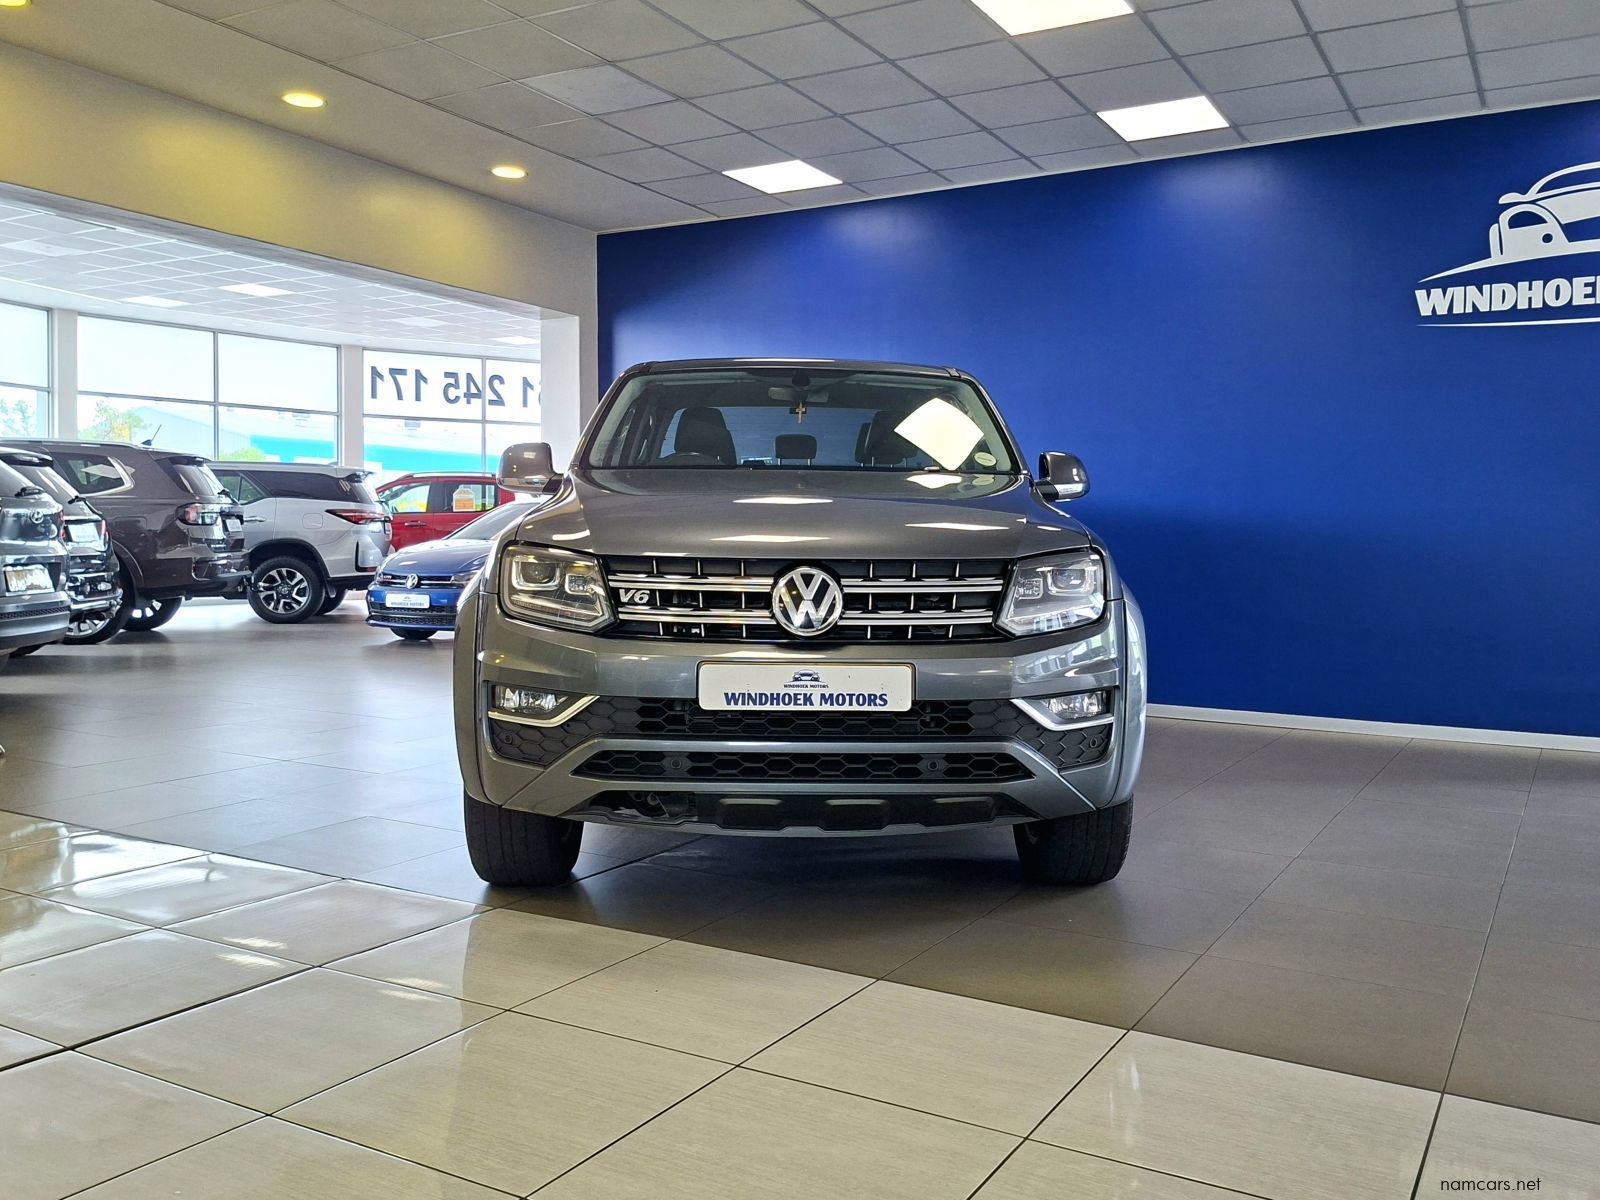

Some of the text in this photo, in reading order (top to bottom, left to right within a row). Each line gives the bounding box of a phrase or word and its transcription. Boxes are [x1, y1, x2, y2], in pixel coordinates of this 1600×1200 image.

[1415, 276, 1600, 317] WINDHOE
[618, 589, 650, 604] V6
[724, 692, 888, 707] WINDHOEK MOTORS
